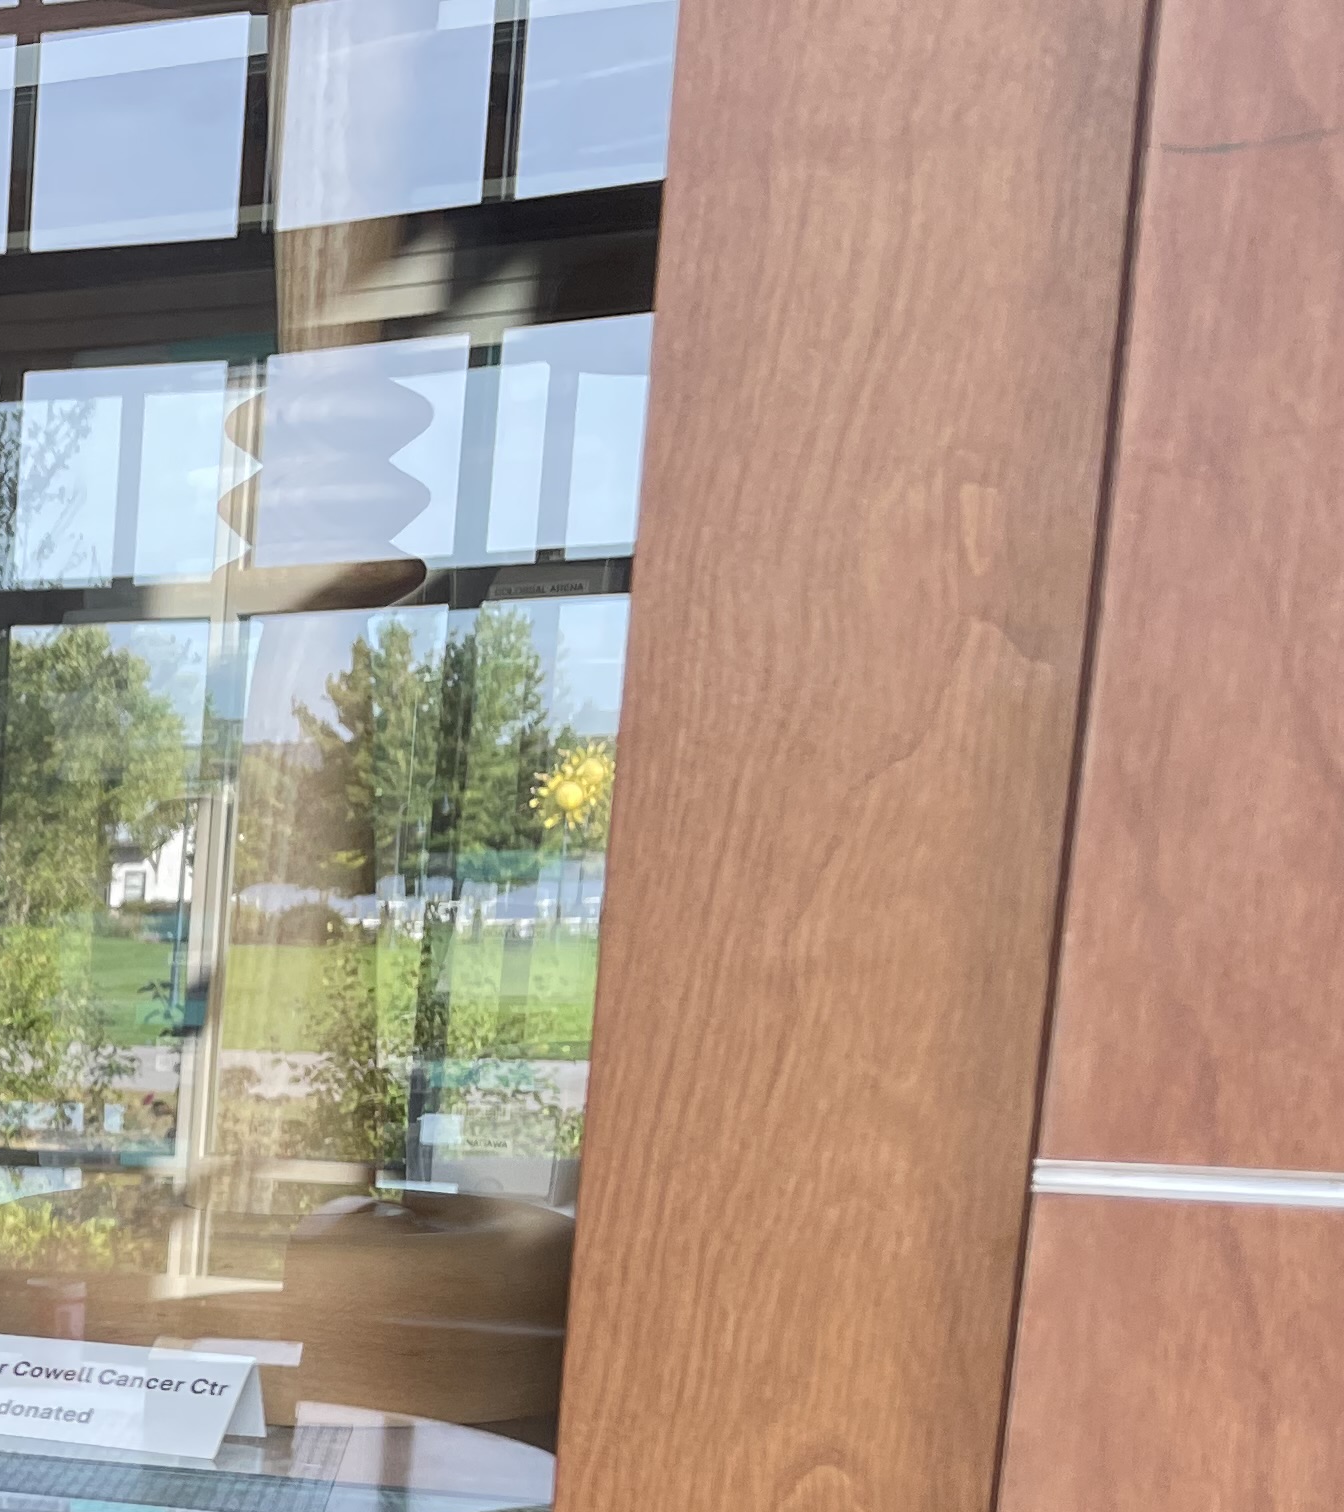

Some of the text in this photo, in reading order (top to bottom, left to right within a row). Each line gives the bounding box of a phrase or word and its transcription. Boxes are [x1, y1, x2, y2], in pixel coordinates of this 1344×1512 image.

[550, 583, 584, 593] ARENA
[13, 1360, 93, 1384] Cowell
[98, 1369, 185, 1393] Cancer
[190, 1377, 230, 1397] Ctr
